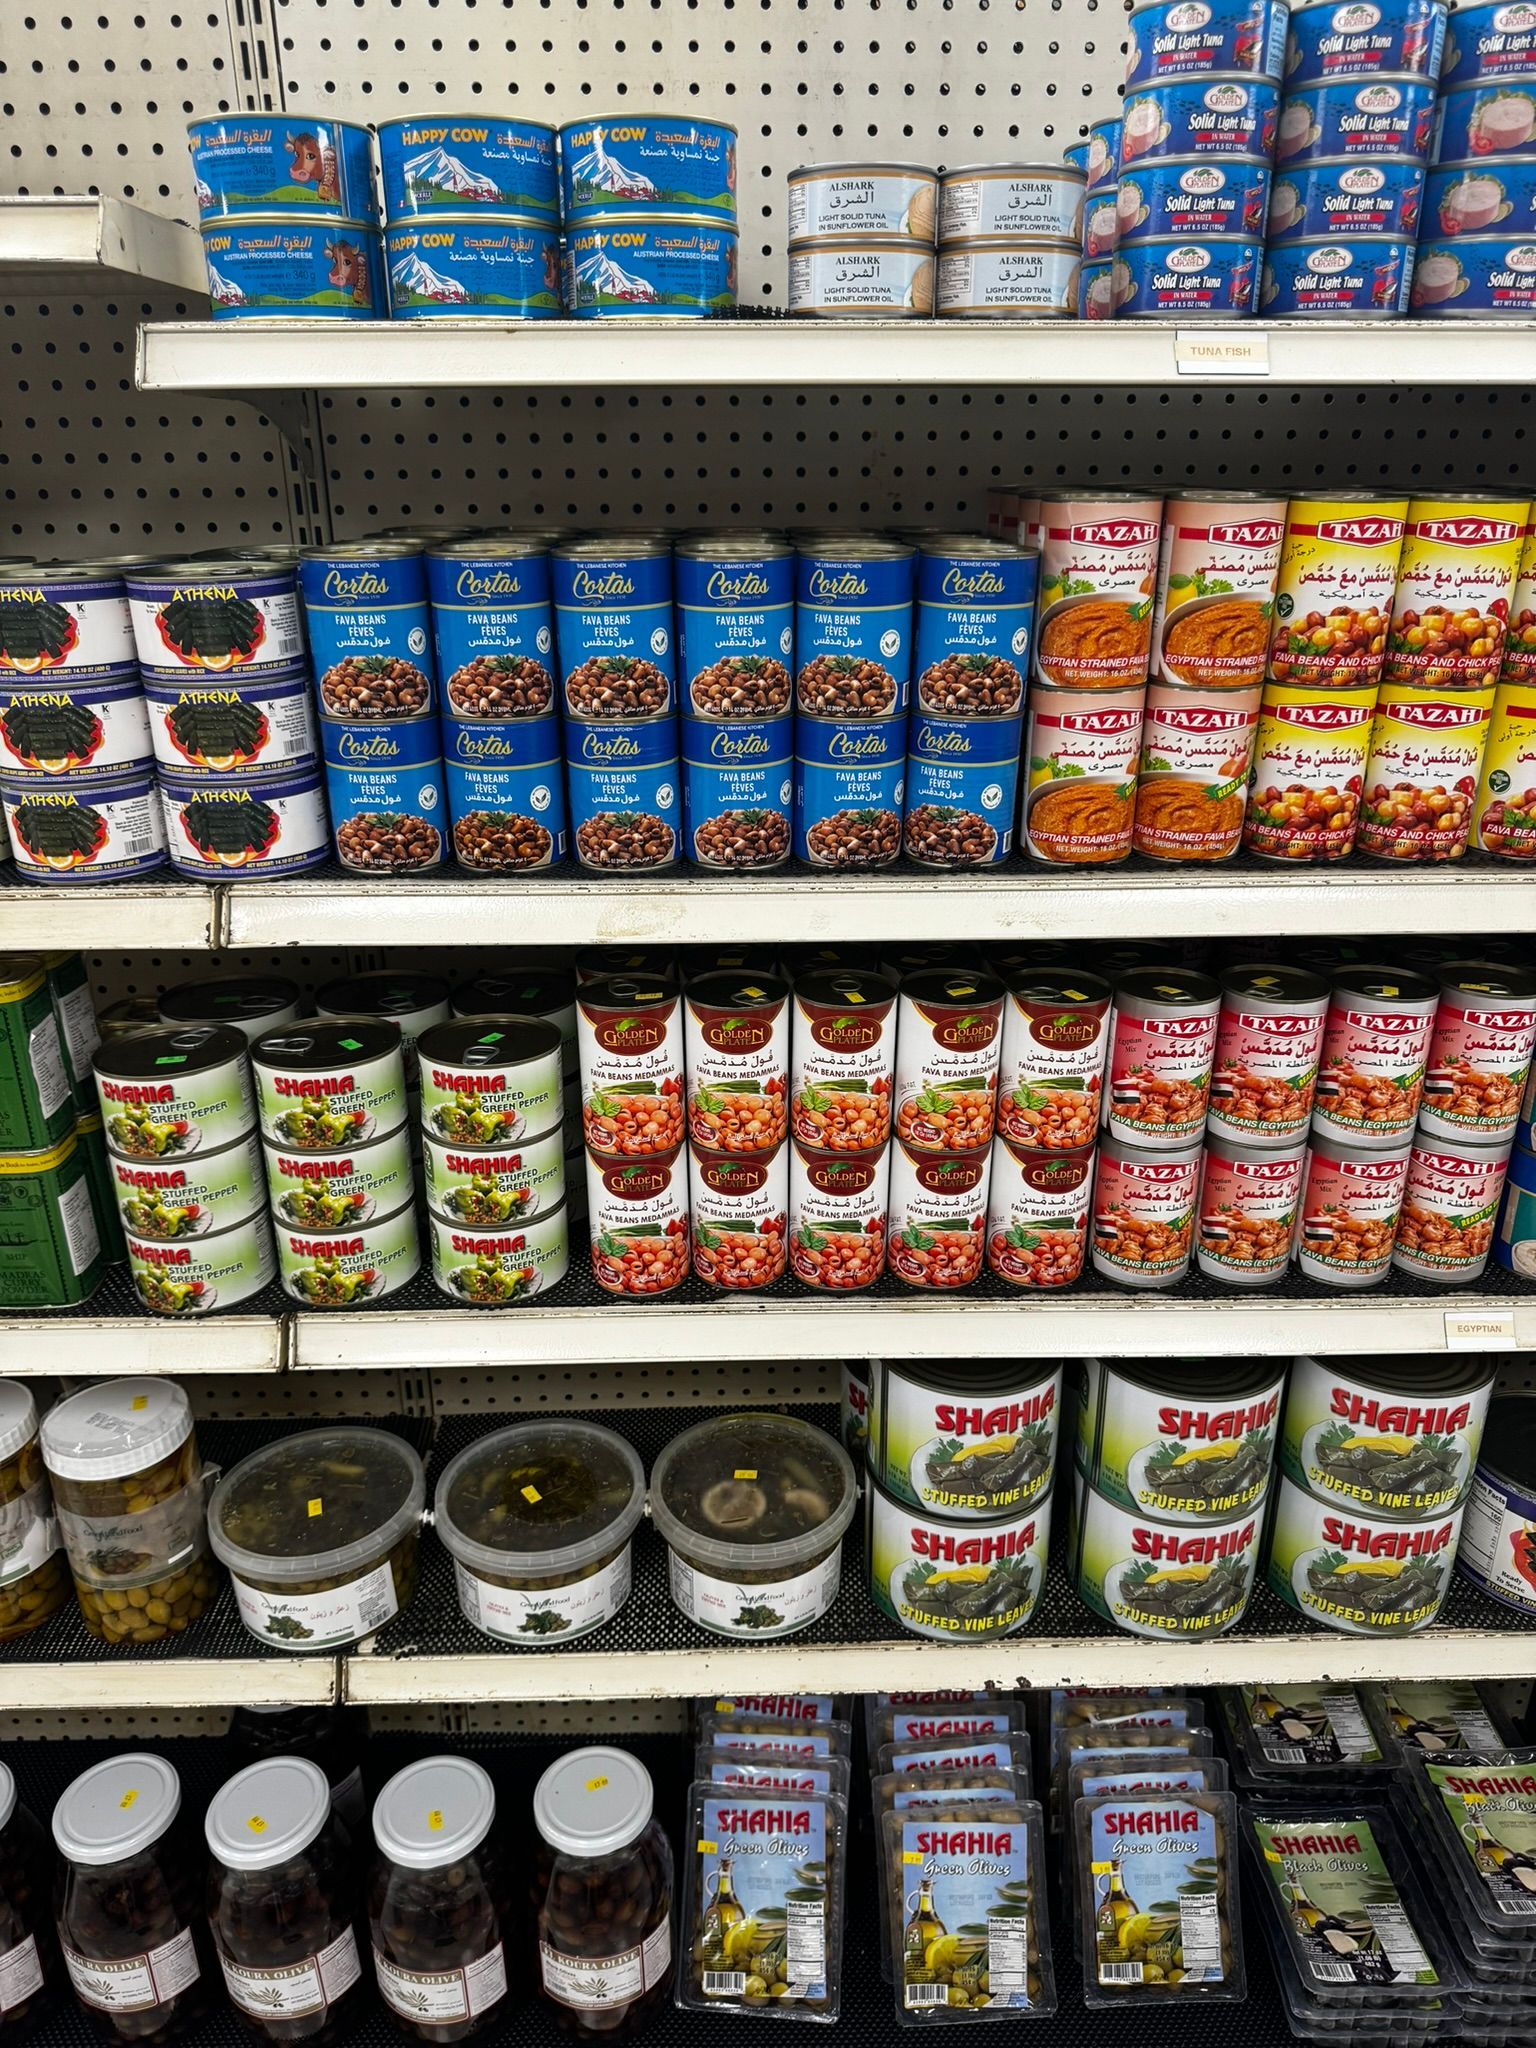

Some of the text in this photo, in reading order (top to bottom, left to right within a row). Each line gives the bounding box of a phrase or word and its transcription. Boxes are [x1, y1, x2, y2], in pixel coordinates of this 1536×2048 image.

[1153, 34, 1175, 54] Solid
[1317, 36, 1343, 55] Solid
[1188, 112, 1216, 130] Solid
[1339, 115, 1365, 132] Solid
[402, 129, 448, 146] HAPPY
[611, 128, 647, 142] COW
[247, 146, 273, 154] CHEESE
[830, 182, 874, 192] ALSHARK
[1009, 184, 1052, 192] ALSHARK
[830, 192, 874, 208] الشرق
[1008, 194, 1052, 209] الشرق
[1165, 196, 1235, 212] Solid Light Tuna
[1323, 195, 1374, 212] Solid Light
[818, 214, 838, 222] LIGHT
[826, 222, 868, 231] SUNFLOWER
[870, 222, 888, 230] OIL
[994, 222, 1001, 230] IN
[1002, 222, 1048, 232] SUNFLOWER
[421, 234, 455, 247] COW
[612, 234, 647, 247] COW
[287, 251, 313, 259] CHEESE
[836, 257, 880, 265] ALSHARK
[999, 257, 1043, 265] ALSHARK
[846, 286, 869, 294] SOLID
[1152, 274, 1221, 290] Solid Light Tuna
[1292, 274, 1363, 290] Solid Light Tuna
[1191, 347, 1251, 357] TUNA FISH
[1426, 523, 1511, 539] TAZAH
[324, 570, 389, 599] Cortas
[456, 569, 521, 599] Cortas
[573, 571, 635, 600] Cortas
[707, 571, 769, 600] Cortas
[809, 569, 868, 599] Cortas
[942, 568, 1005, 598] Cortas
[172, 587, 238, 603] ATHENA
[335, 614, 387, 625] FAVA BEANS
[716, 615, 765, 625] FAVA BEANS
[948, 613, 997, 623] FAVA BEANS
[1040, 656, 1128, 668] EGYPTIAN STRAINED
[1166, 654, 1258, 667] EGYPTIAN STRAINED
[1275, 652, 1356, 666] FAVA BEANS AND
[1394, 654, 1488, 667] BEANS AND CHICK
[1065, 669, 1086, 677] NET
[10, 693, 74, 708] ATHENA
[178, 691, 242, 706] ATHENA
[1161, 710, 1240, 727] TAZAH
[1286, 708, 1363, 724] TAZAH
[1396, 705, 1476, 723] TAZAH
[338, 733, 400, 760] Cortas
[711, 731, 770, 759] Cortas
[828, 731, 887, 758] Cortas
[917, 726, 971, 756] Cortas
[349, 774, 397, 784] FAVA BEANS
[836, 771, 882, 781] FAVA BEANS
[20, 793, 79, 807] ATHENA
[191, 789, 253, 803] ATHENA
[1029, 829, 1115, 845] EGYPTIAN STRAINED
[1153, 828, 1225, 841] STRAINED FAVA
[1258, 826, 1346, 840] BEANS AND CHICK
[1357, 1016, 1428, 1030] TAZAH
[608, 1064, 675, 1080] BEANS MEDAMMAS
[820, 1065, 887, 1078] BEANS MEDAMMAS
[433, 1069, 506, 1094] SHAHIA
[102, 1081, 174, 1103] SHAHIA
[481, 1092, 525, 1103] STUFFED
[150, 1101, 196, 1113] STUFFED
[482, 1092, 549, 1113] GREEN PEPPER
[151, 1101, 228, 1124] GREEN PEPPER
[1444, 1112, 1478, 1124] BEANS
[1133, 1120, 1166, 1131] BEANS
[446, 1154, 522, 1176] SHAHIA
[1415, 1150, 1489, 1175] TAZAH
[116, 1165, 186, 1188] SHAHIA
[926, 1168, 977, 1185] GOLDEN
[1129, 1164, 1195, 1179] TAZAH
[925, 1208, 950, 1218] BEANS
[1460, 1212, 1484, 1228] READY
[451, 1234, 526, 1256] SHAHIA
[1221, 1255, 1253, 1267] BEANS
[168, 1264, 212, 1275] STUFFED
[170, 1262, 244, 1284] GREEN PEPPER
[1457, 1325, 1502, 1333] EGYPTIAN
[935, 1383, 1055, 1437] SHAHIA
[1158, 1390, 1278, 1441] SHAHIA
[1330, 1387, 1470, 1437] SHAHIA
[1308, 1466, 1460, 1508] STUFFED VINE LEAVES
[922, 1487, 1020, 1508] STUFFED VINE
[911, 1520, 1036, 1565] SHAHIA
[1131, 1520, 1255, 1564] SHAHIA
[1322, 1517, 1453, 1559] SHAHIA
[1486, 1580, 1520, 1602] STUFFED
[899, 1595, 1036, 1632] STUFFED VINE LEAVES
[717, 1809, 810, 1834] SHAHIA
[1104, 1810, 1198, 1836] SHAHIA
[723, 1838, 809, 1856] Green Olives
[917, 1831, 1012, 1857] SHAHIA
[1112, 1839, 1198, 1855] Green Olives
[1270, 1834, 1361, 1856] SHAHIA
[923, 1859, 1011, 1877] Green Olives
[1283, 1857, 1368, 1874] Black Olives
[559, 1952, 639, 1970] KOURA OLIVE
[274, 1963, 313, 1980] OLIVE
